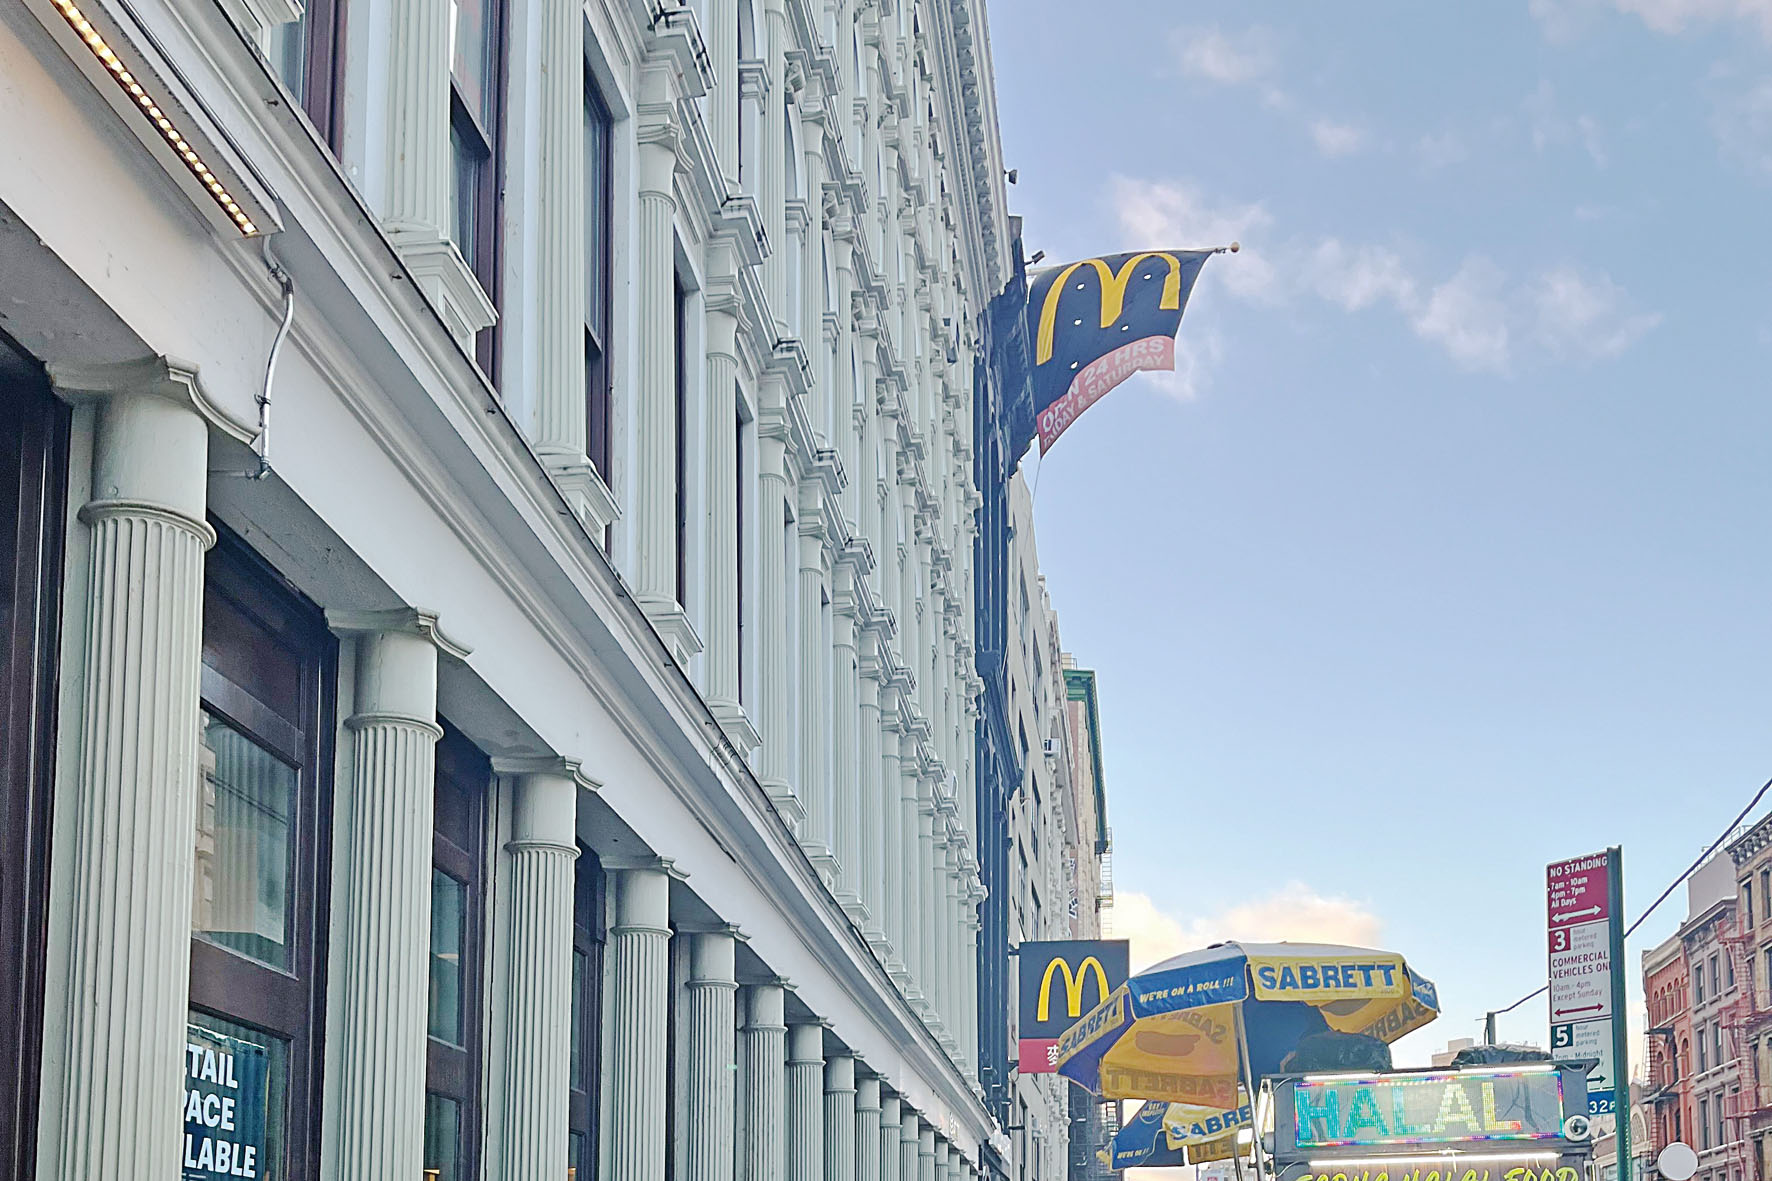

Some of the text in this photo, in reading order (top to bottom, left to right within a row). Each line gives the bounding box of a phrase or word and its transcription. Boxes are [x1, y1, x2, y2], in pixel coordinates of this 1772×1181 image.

[1043, 339, 1165, 433] OPN 24 HRS
[1088, 355, 1165, 399] SATURDAY
[1550, 856, 1608, 878] NO STANDING
[1551, 881, 1565, 892] 7am
[1570, 875, 1588, 886] 10am
[1551, 890, 1566, 901] 4pm
[1571, 886, 1586, 897] 7pm
[1551, 896, 1577, 909] All Days
[1554, 930, 1566, 951] 3
[1573, 932, 1597, 942] metered
[1573, 941, 1595, 951] parking
[1552, 950, 1608, 968] COMMERCIAL
[1258, 963, 1396, 990] SABRETT
[1553, 961, 1611, 980] VEHICLES ON
[1140, 989, 1169, 1003] WE'RE
[1171, 986, 1185, 996] ON
[1187, 984, 1194, 993] A
[1196, 980, 1220, 992] ROLL
[1553, 983, 1571, 993] 10am
[1576, 980, 1591, 990] 4pm
[1553, 989, 1603, 1003] Except Sunday
[1556, 1025, 1569, 1047] 5
[1576, 1030, 1600, 1038] metered
[1576, 1037, 1598, 1047] parking
[1575, 1049, 1603, 1060] Midnight
[184, 1043, 239, 1090] TAIL
[183, 1088, 236, 1132] ACE
[1297, 1081, 1522, 1140] HALAL
